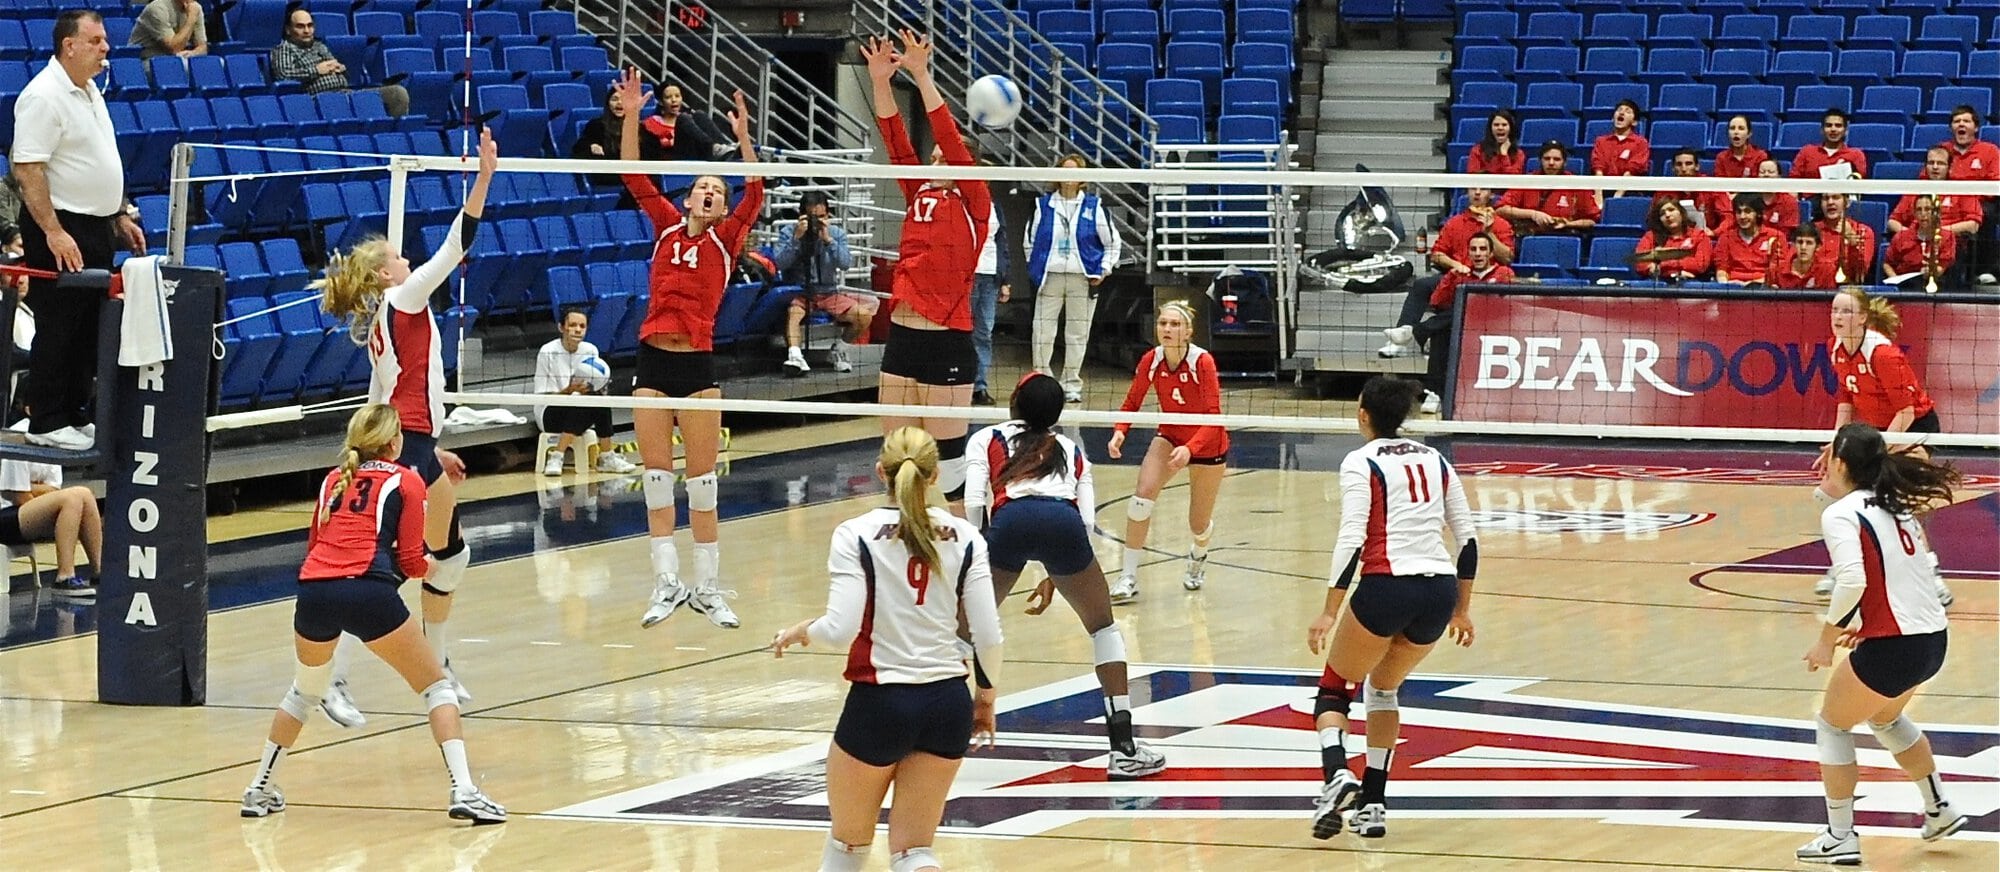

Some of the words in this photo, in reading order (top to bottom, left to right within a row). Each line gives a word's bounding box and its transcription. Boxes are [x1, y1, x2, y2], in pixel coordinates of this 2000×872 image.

[914, 197, 938, 222] 17
[671, 241, 698, 269] 14
[1473, 335, 1695, 397] BEAR
[1676, 340, 1910, 397] DOW
[1845, 374, 1860, 394] 6
[1171, 387, 1187, 404] 4
[124, 361, 165, 627] RIZONA
[1403, 463, 1431, 503] 11
[1894, 516, 1916, 556] 6
[906, 555, 930, 606] 9
